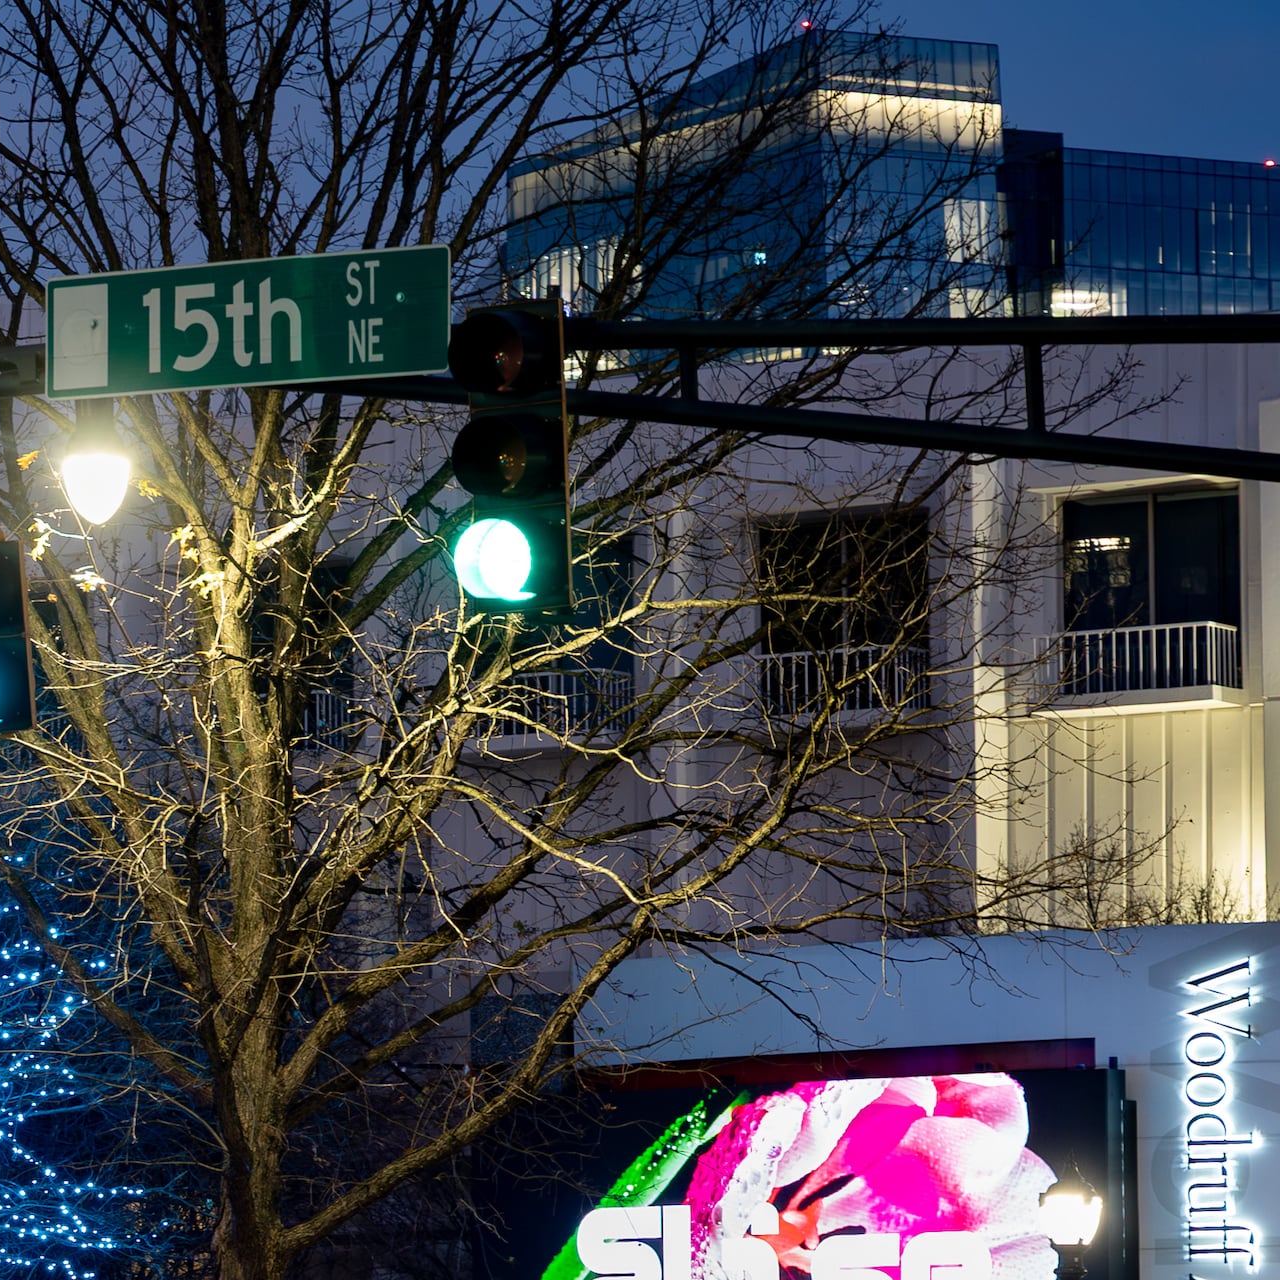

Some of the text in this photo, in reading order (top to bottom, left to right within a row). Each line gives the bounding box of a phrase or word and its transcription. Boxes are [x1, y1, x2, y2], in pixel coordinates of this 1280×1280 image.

[346, 260, 380, 307] ST
[142, 276, 303, 374] 15th
[348, 317, 384, 364] NE
[1182, 955, 1255, 1267] Woodruff
